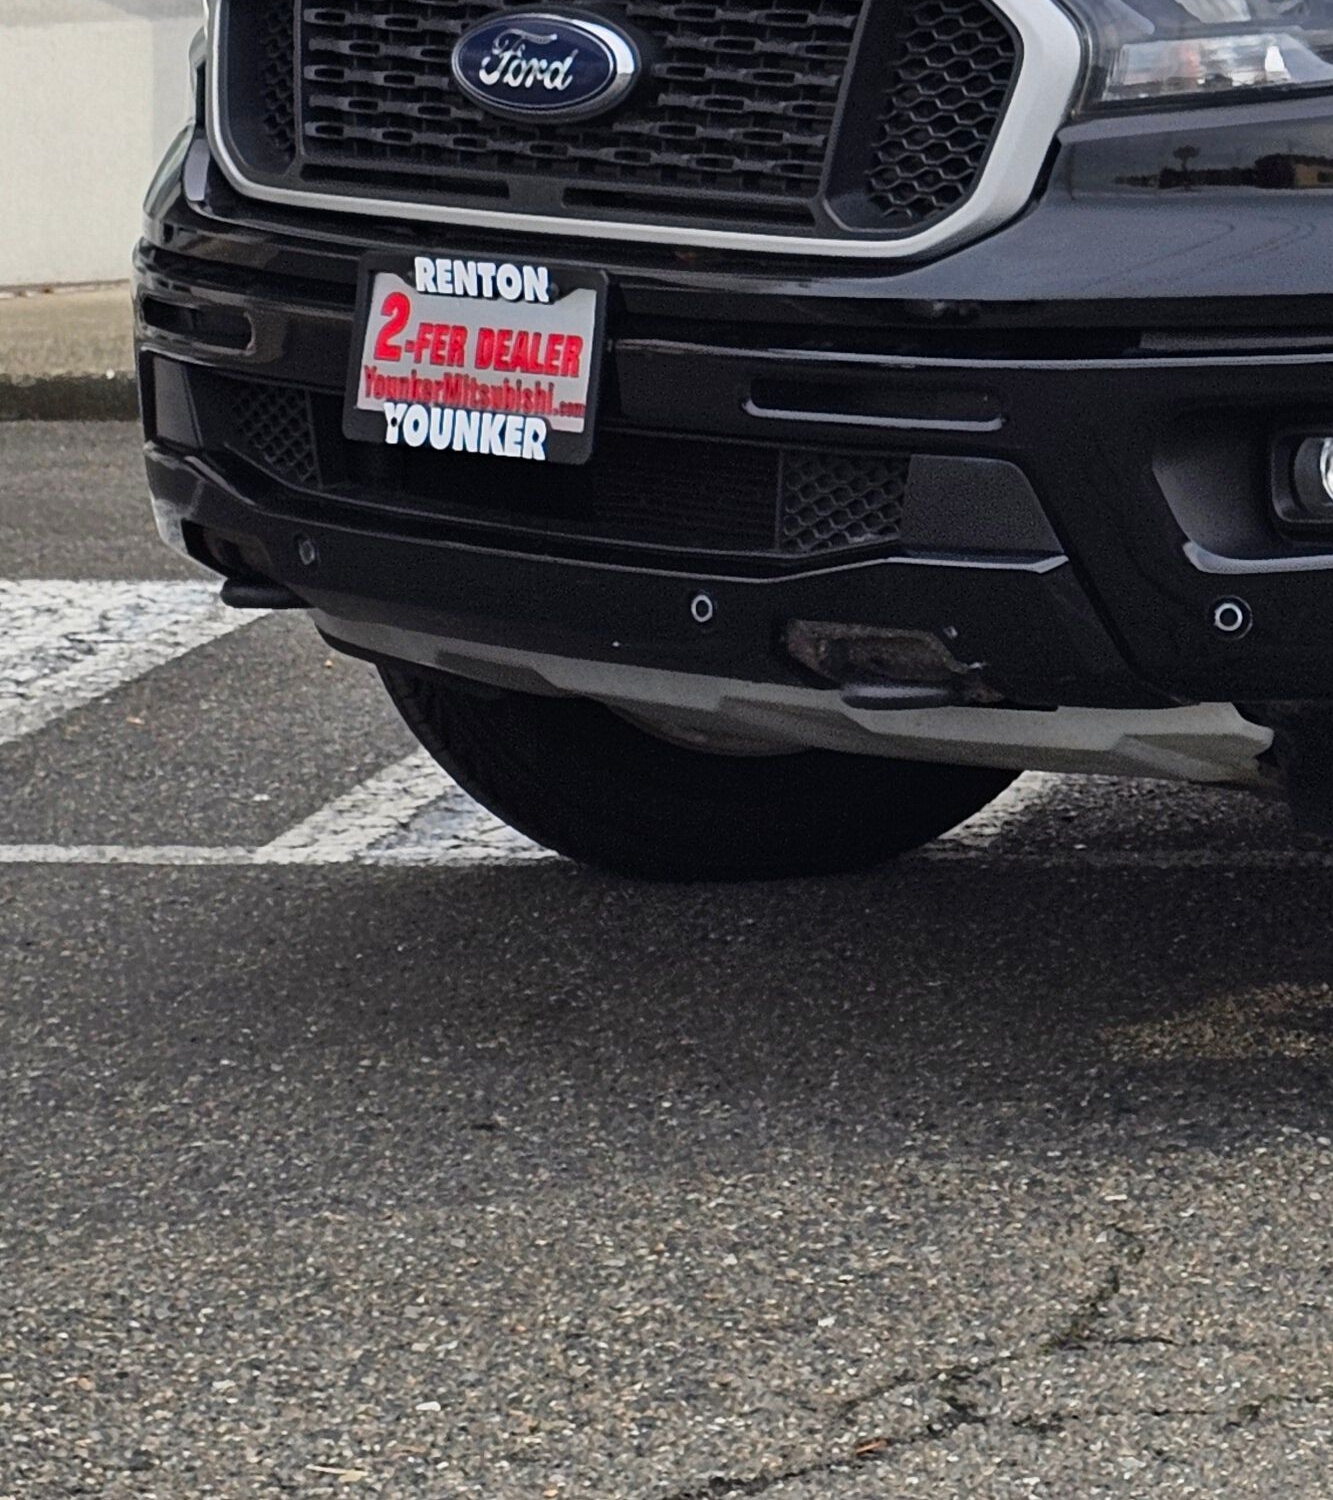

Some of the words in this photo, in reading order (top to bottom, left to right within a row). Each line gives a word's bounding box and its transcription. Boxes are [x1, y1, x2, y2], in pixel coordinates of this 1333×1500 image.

[478, 27, 575, 93] Ford
[414, 256, 550, 303] RENTON
[374, 292, 468, 368] 2-FER
[474, 327, 583, 378] DEALER
[383, 401, 548, 461] YOUNKER
